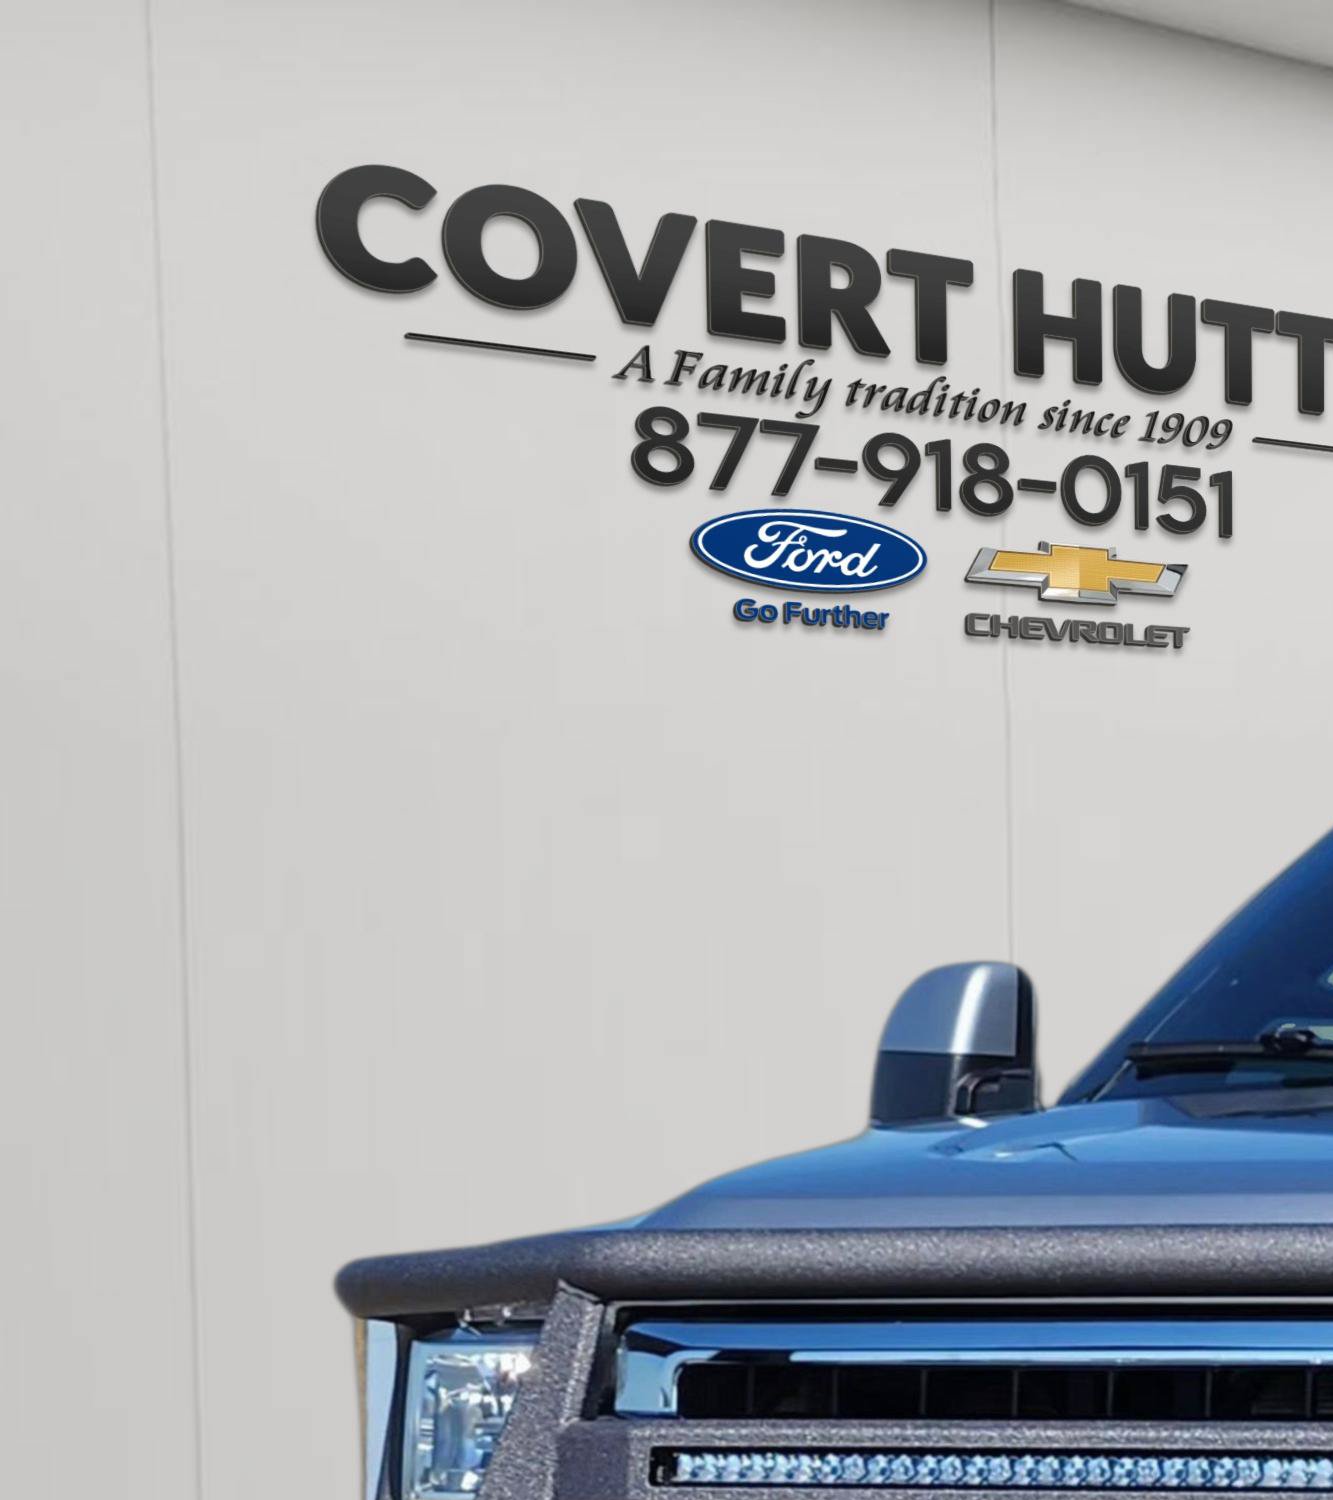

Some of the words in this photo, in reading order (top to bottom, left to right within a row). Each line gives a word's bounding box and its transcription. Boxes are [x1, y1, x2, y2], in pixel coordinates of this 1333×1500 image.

[315, 164, 974, 367] COVERT
[612, 344, 655, 384] A
[663, 349, 833, 420] Family
[845, 375, 1027, 427] tradition
[1037, 401, 1131, 439] since
[1138, 410, 1234, 451] 1909
[630, 406, 1233, 540] 877-918-0151
[743, 520, 881, 580] Ford
[732, 598, 779, 625] Go
[782, 601, 890, 631] Further
[964, 612, 1190, 650] CHEVROLET
